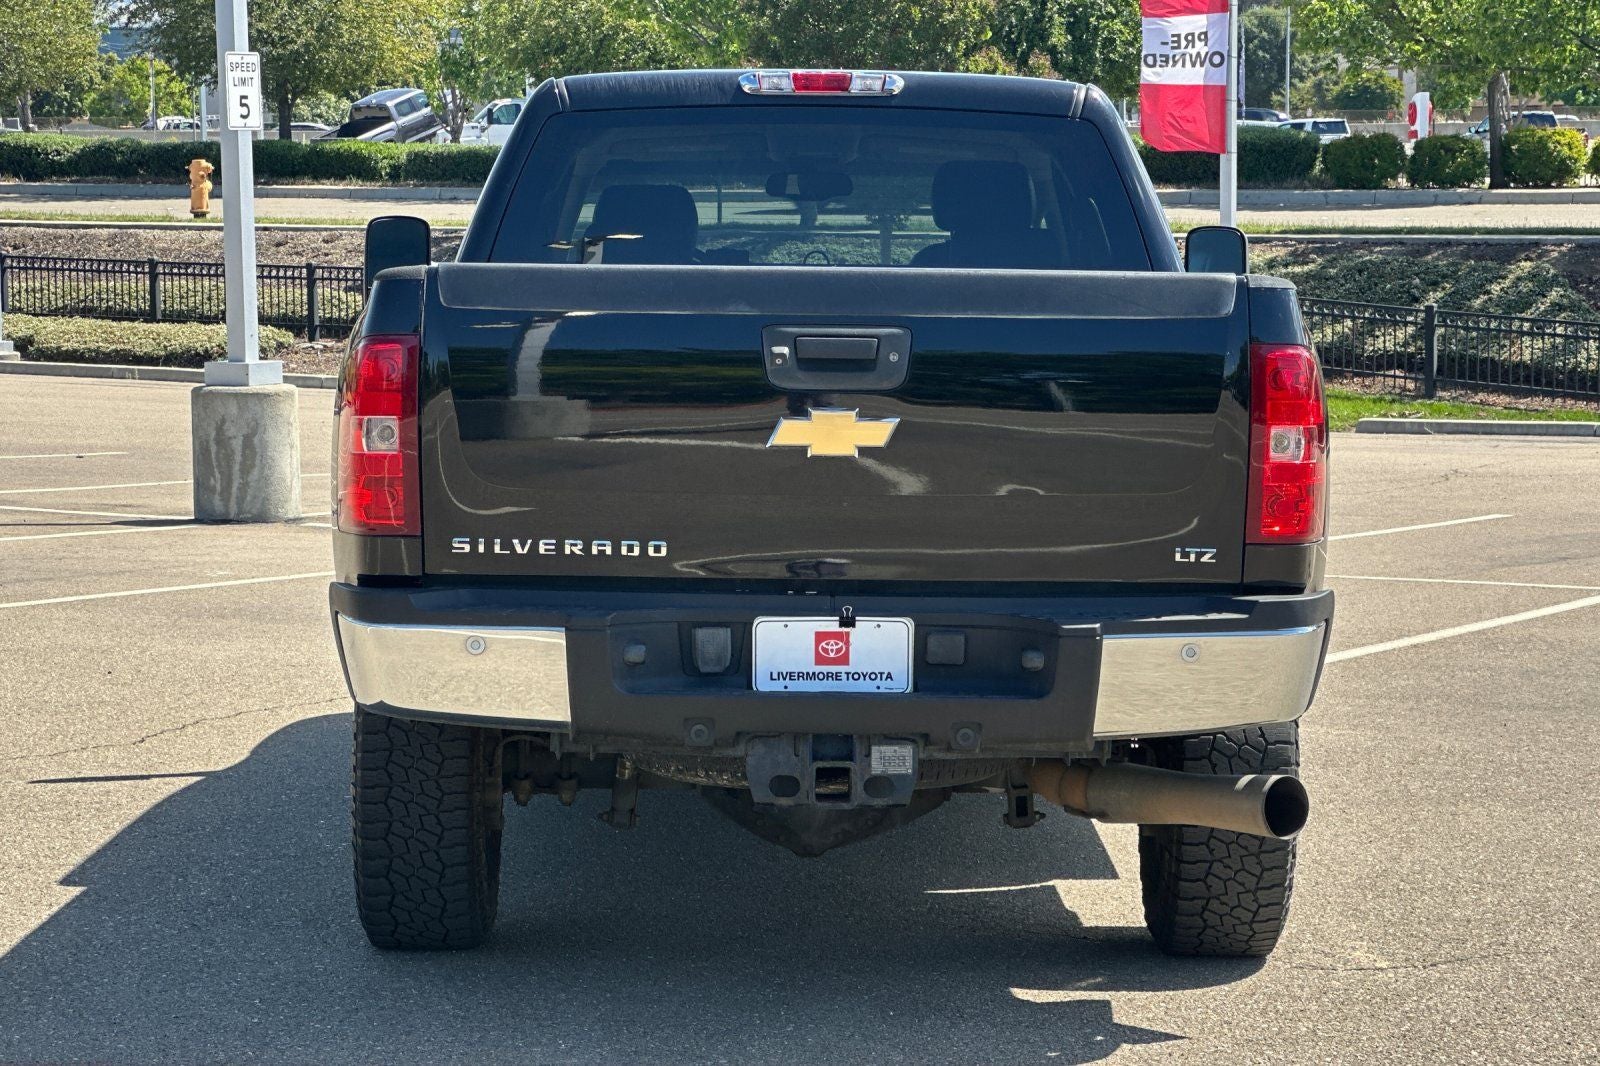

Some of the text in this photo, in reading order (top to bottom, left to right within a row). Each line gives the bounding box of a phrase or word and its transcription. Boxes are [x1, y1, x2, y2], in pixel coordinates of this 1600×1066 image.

[229, 61, 257, 73] SPEED
[233, 76, 254, 87] LIMIT
[239, 95, 251, 119] 5
[451, 537, 668, 557] SILVERADO
[1175, 547, 1217, 563] LTZ
[769, 671, 894, 682] LIVERMORE TOYOTA
